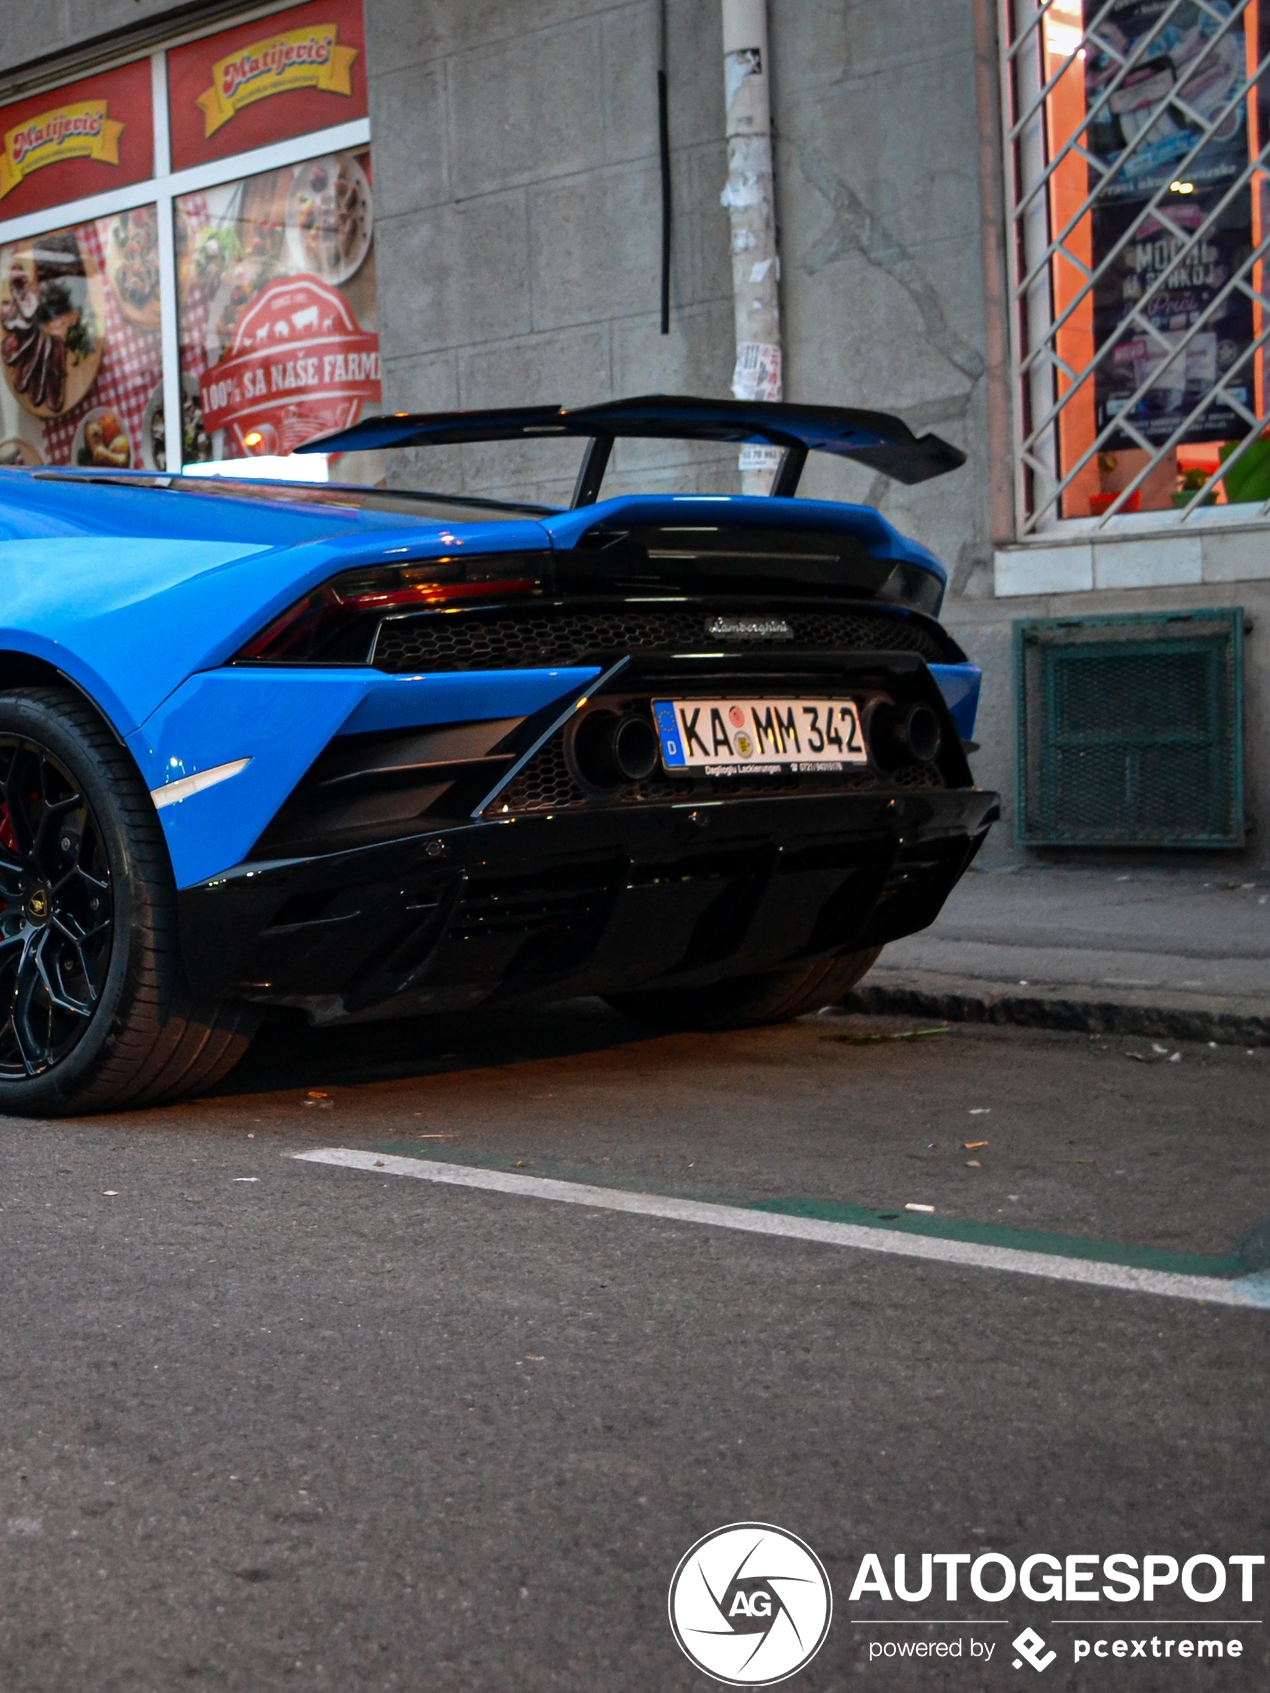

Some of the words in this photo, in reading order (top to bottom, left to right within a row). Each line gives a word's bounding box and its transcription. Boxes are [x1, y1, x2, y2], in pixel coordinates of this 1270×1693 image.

[222, 36, 333, 99] Matijević
[12, 110, 104, 165] Matijević
[243, 368, 267, 398] SA
[270, 353, 319, 391] NAŠE
[323, 352, 381, 382] FARM
[709, 616, 788, 636] Lamborghini
[667, 741, 677, 755] D
[679, 707, 734, 757] KA
[751, 707, 802, 755] MM
[802, 706, 863, 754] 342
